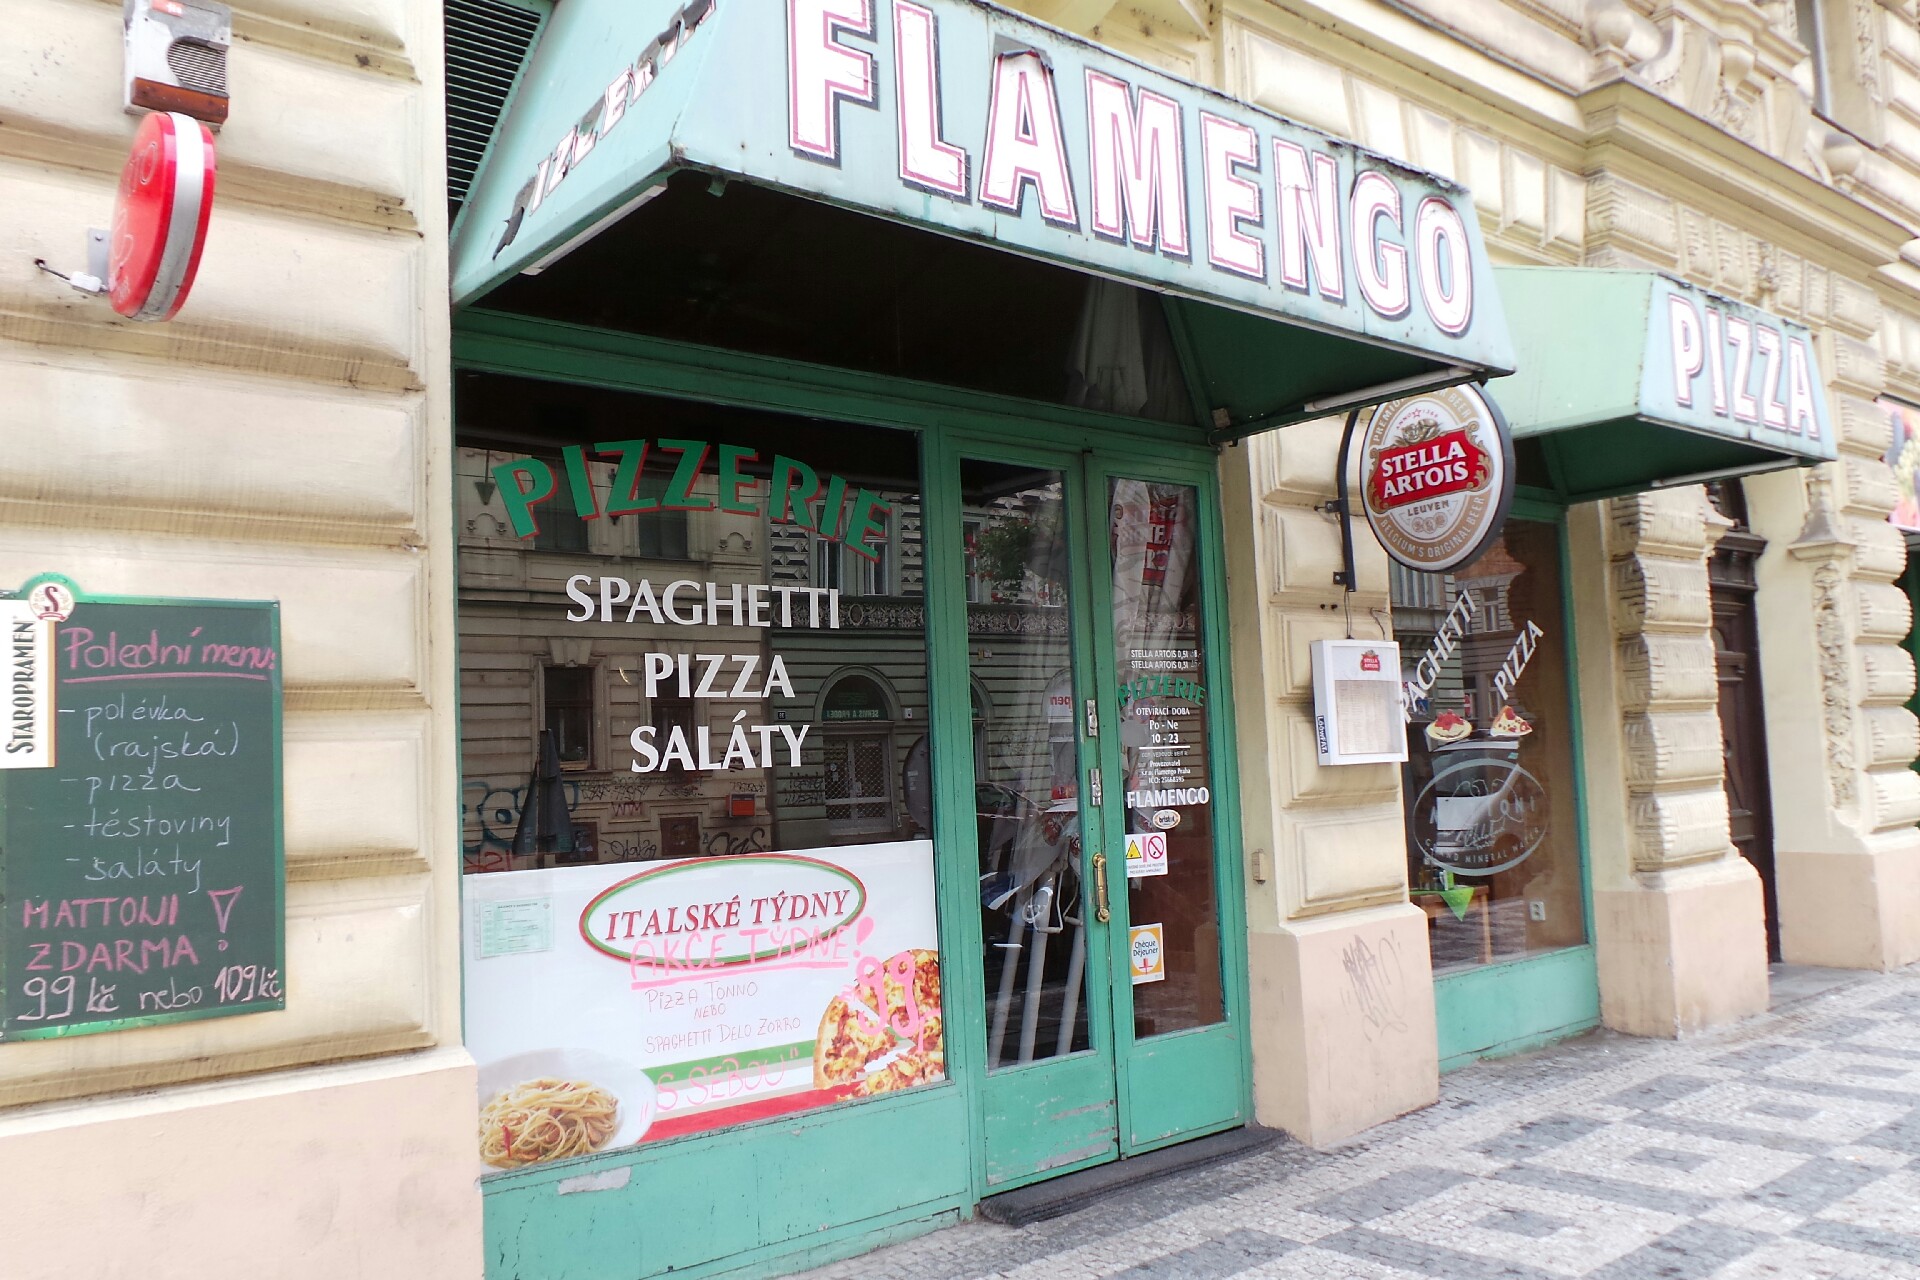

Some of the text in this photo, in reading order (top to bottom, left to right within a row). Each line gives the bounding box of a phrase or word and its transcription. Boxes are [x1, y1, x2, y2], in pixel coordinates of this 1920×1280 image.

[787, 0, 1477, 337] FLAMENGO
[1668, 293, 1820, 442] PIZZA
[1381, 441, 1468, 478] STELLA
[1383, 461, 1469, 499] ARTOIS
[491, 438, 893, 564] PIZZERIE
[1407, 500, 1450, 517] LEUVEN
[1380, 497, 1486, 558] BELGIUM'S ORIGINAL BEER
[566, 574, 840, 629] SPAGHETTI
[59, 626, 203, 670] Polední
[1131, 649, 1153, 658] STELLA
[1154, 649, 1177, 658] ARTOIS
[1131, 660, 1153, 669] STELLA
[1154, 660, 1177, 669] ARTOIS
[1494, 619, 1544, 700] PIZZA
[6, 621, 36, 754] STAROPRAMEN
[644, 652, 796, 698] PIZZA
[1117, 675, 1207, 707] PIZZERIE
[86, 692, 204, 737] polévka
[1136, 705, 1190, 715] OTEVÍRACÍ DOBA
[1149, 719, 1160, 730] Po
[1167, 719, 1179, 730] Ne
[94, 722, 239, 775] (rajská)
[630, 710, 810, 773] SALÁTY
[1151, 733, 1160, 743] 10
[1168, 733, 1179, 744] 23
[1127, 787, 1209, 809] FLAMENGO
[605, 890, 850, 941] ITALSKÉ TÝDNY
[25, 935, 200, 975] ZDARMA
[630, 930, 729, 980] AKCE
[17, 975, 76, 1021] 99
[139, 977, 203, 1010] nebo
[694, 1003, 727, 1020] NEBO
[704, 980, 759, 1000] TONNO
[719, 1024, 752, 1044] DELO
[757, 1018, 801, 1037] ZORRO
